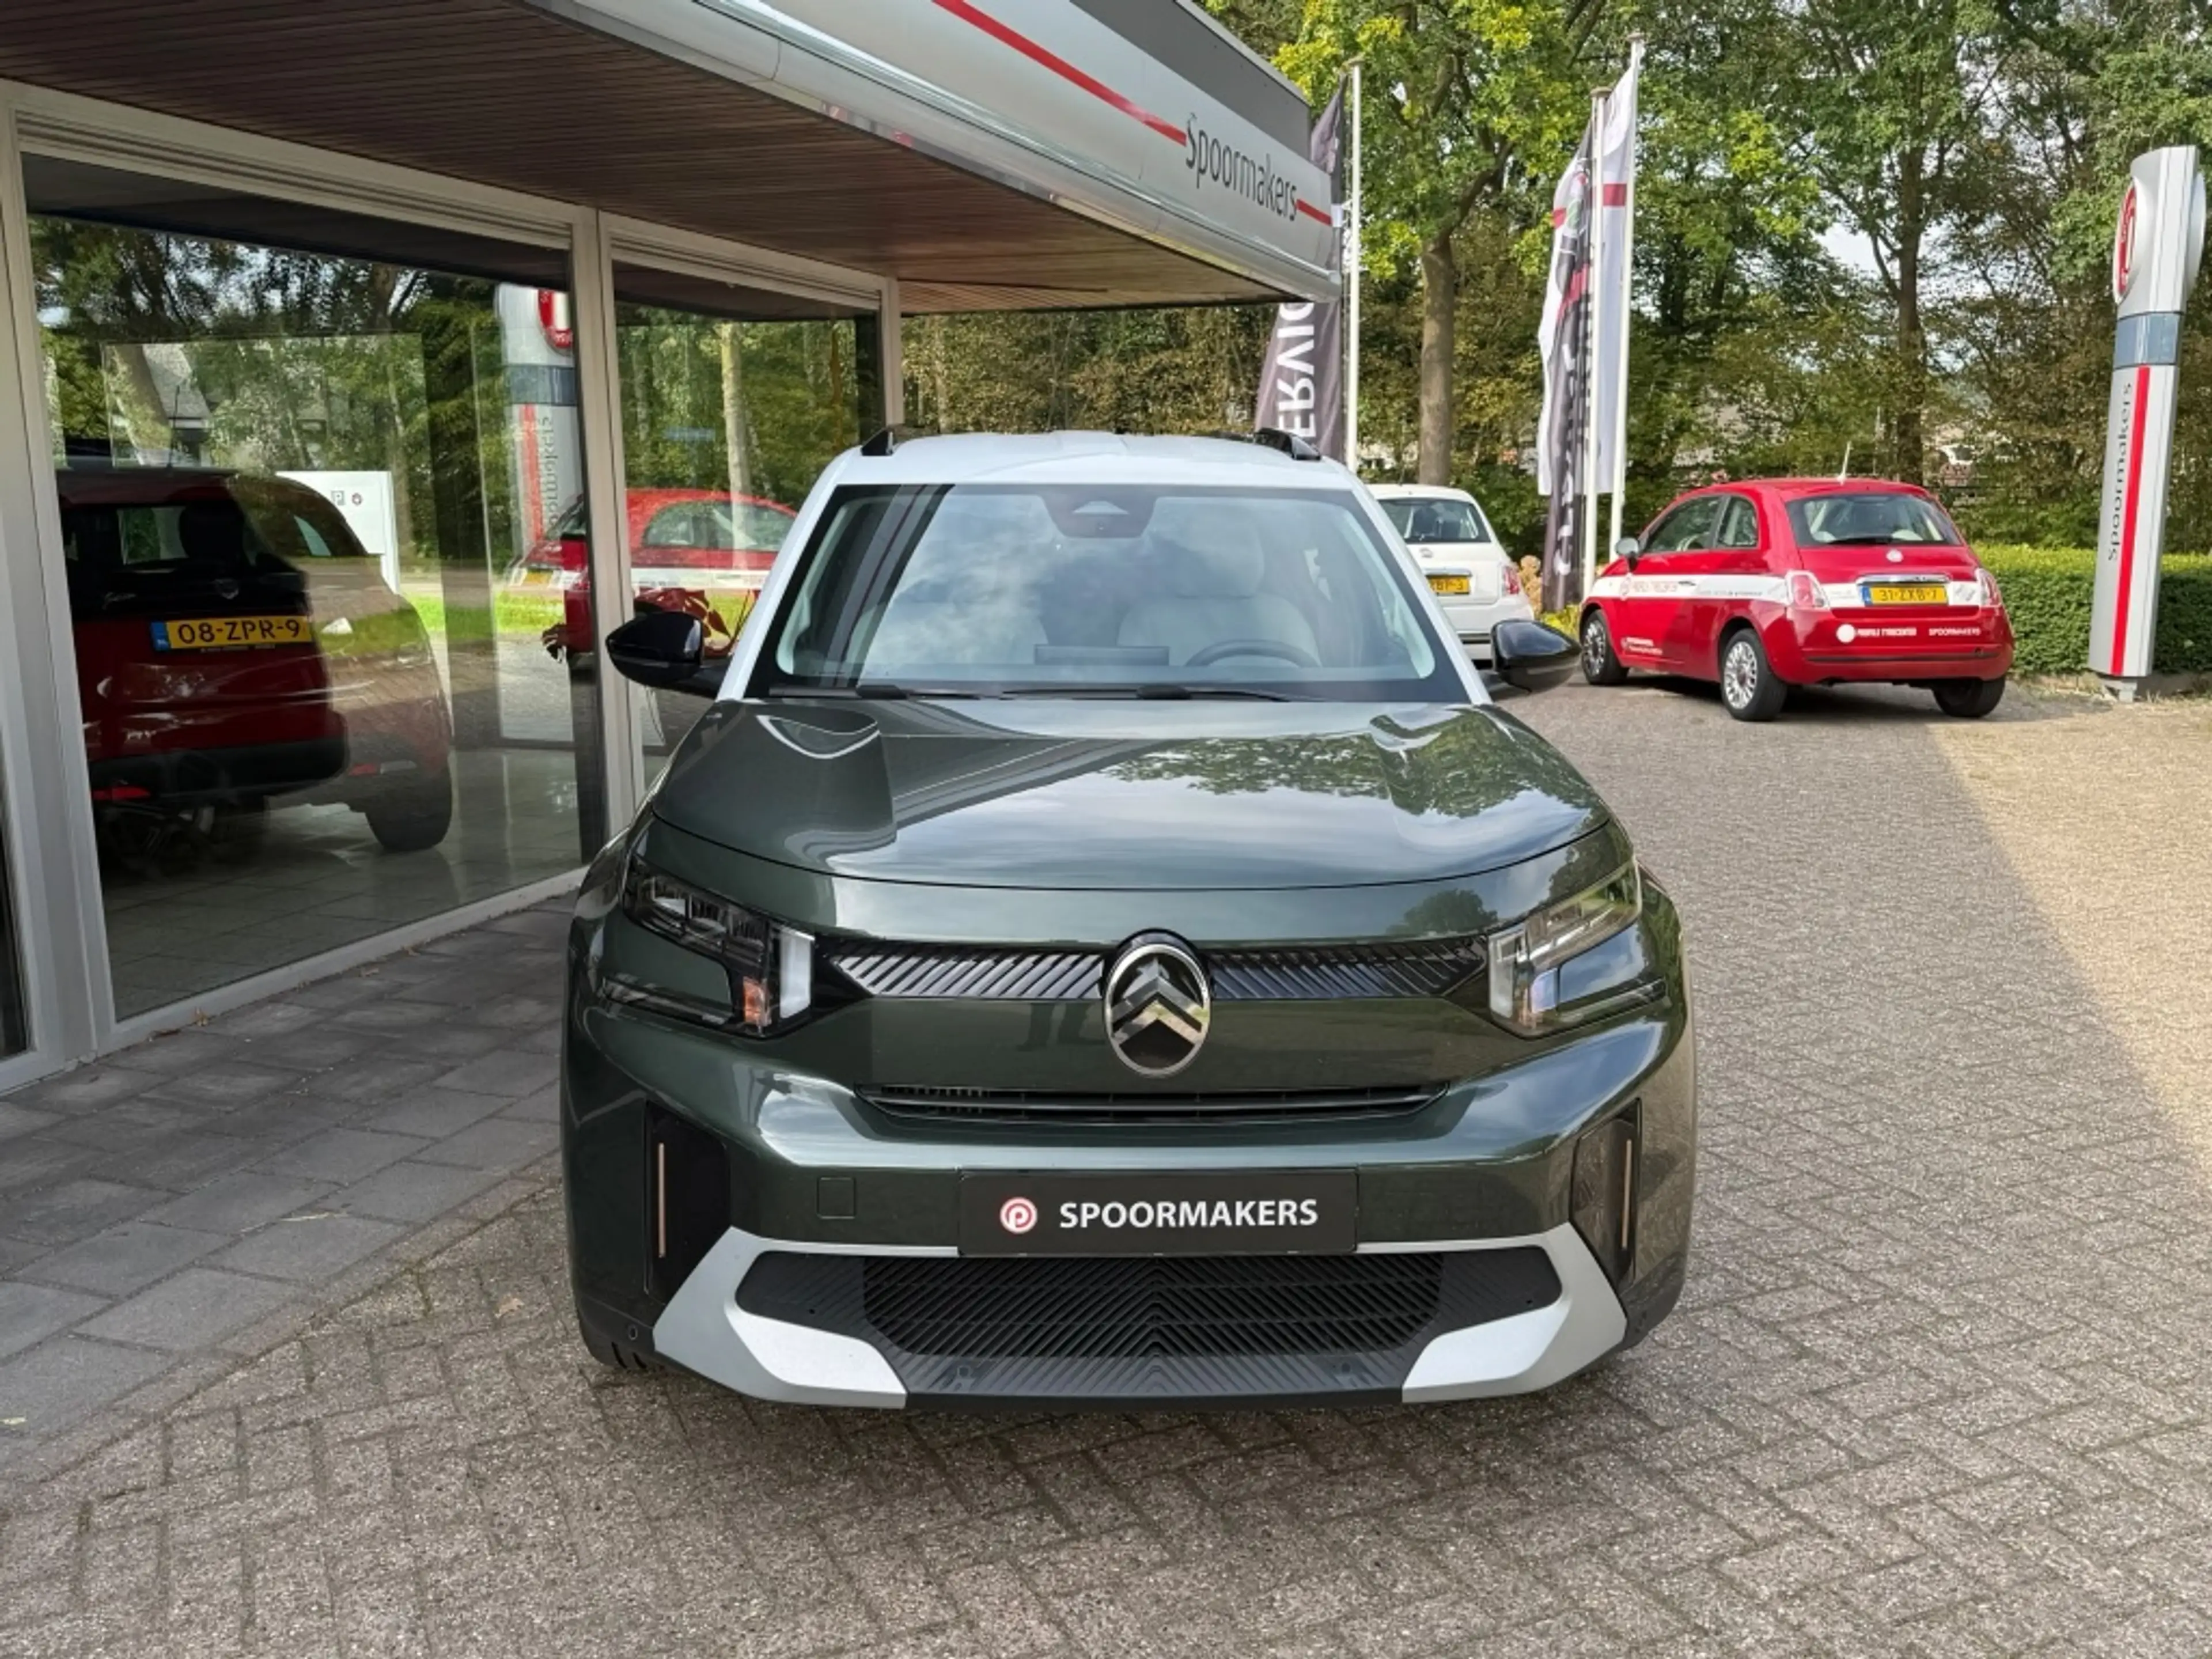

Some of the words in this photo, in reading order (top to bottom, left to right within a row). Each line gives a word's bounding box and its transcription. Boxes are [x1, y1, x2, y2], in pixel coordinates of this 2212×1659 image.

[1185, 112, 1297, 222] Spoormakers
[177, 619, 300, 644] 08-ZPR-9
[1059, 1199, 1319, 1229] SPOORMAKERS
